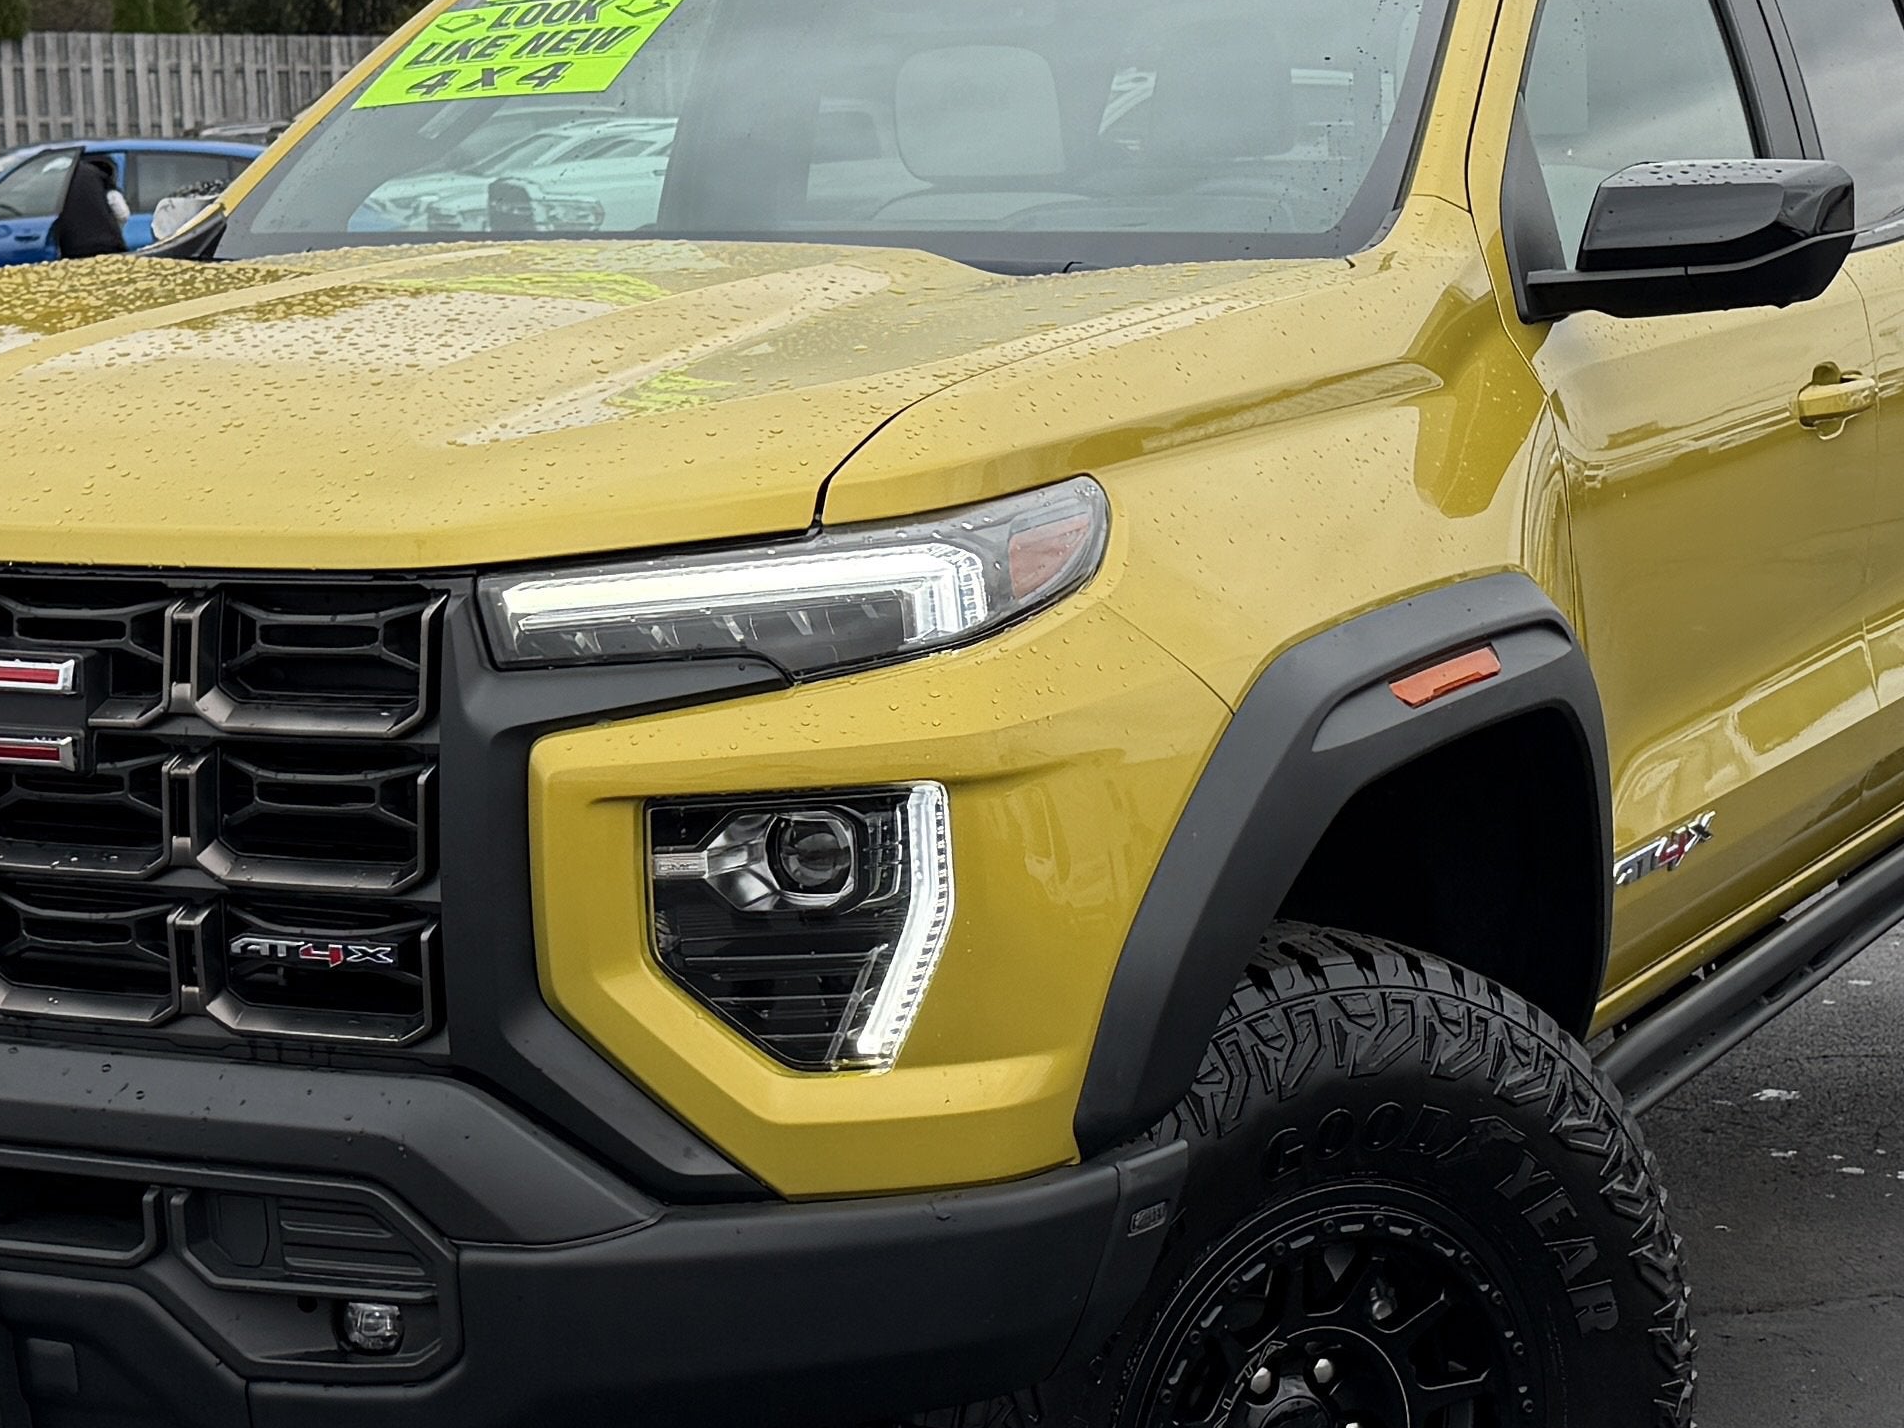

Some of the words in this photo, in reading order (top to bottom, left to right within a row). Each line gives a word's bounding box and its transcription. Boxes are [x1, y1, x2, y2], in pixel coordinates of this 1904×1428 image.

[403, 34, 521, 70] LIKE
[510, 25, 641, 60] NEW
[1612, 810, 1716, 885] AT4X
[230, 936, 394, 968] AT4X
